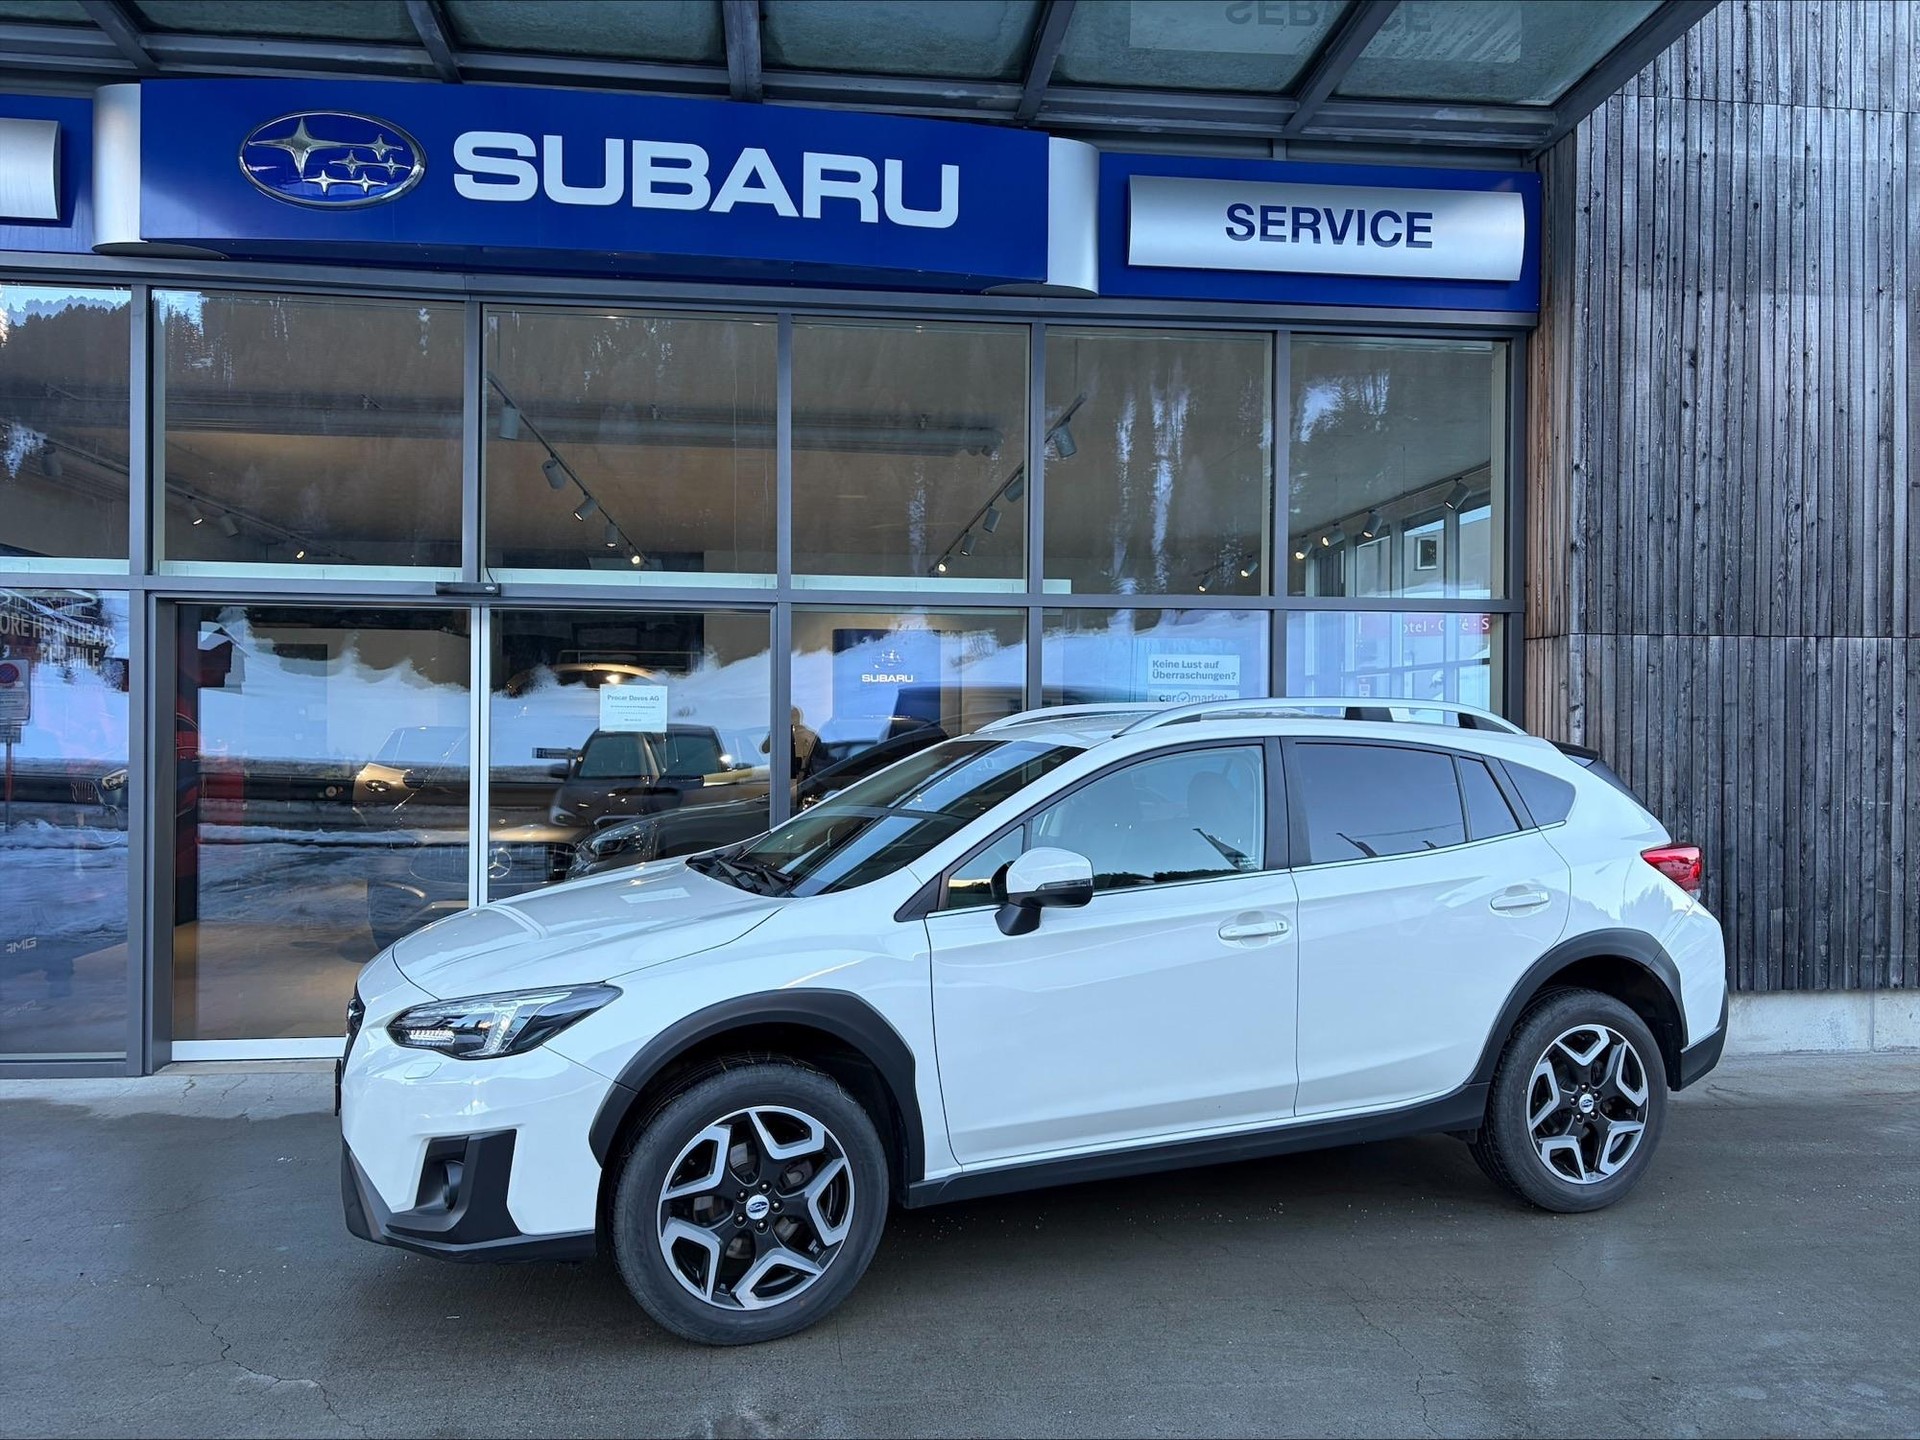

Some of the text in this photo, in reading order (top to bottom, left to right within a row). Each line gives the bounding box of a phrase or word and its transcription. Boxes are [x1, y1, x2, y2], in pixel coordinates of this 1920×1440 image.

[454, 131, 960, 229] SUBARU
[1225, 203, 1433, 249] SERVICE
[1152, 660, 1220, 669] Keine Lust auf
[862, 674, 914, 683] SUBARU
[1152, 669, 1237, 681] Überraschungen?
